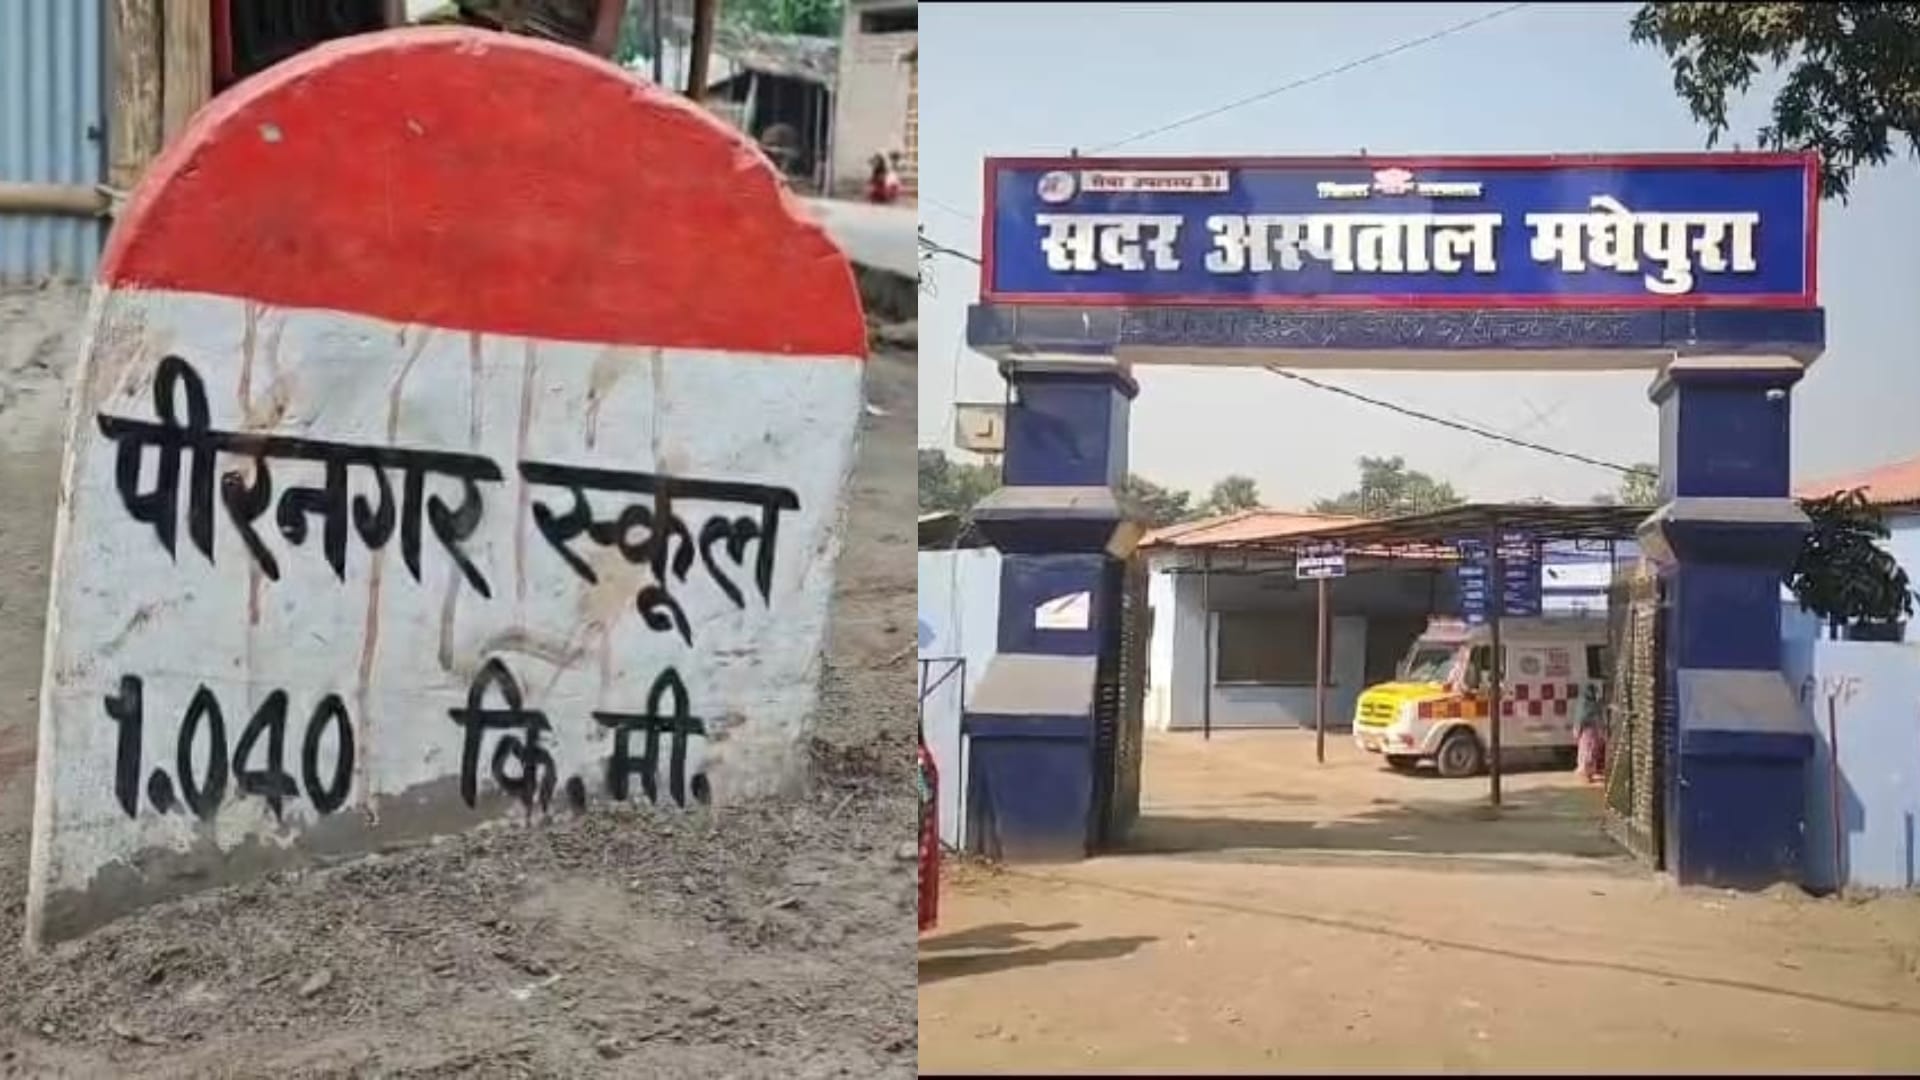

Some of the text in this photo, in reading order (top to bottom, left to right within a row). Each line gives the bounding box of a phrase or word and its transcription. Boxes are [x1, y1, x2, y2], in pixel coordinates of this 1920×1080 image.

[1036, 194, 1759, 294] सदर अस्पताल मधेपुरा
[97, 356, 800, 646] पीरनगर स्कूल
[104, 657, 711, 821] 1.040 कि. मी.
